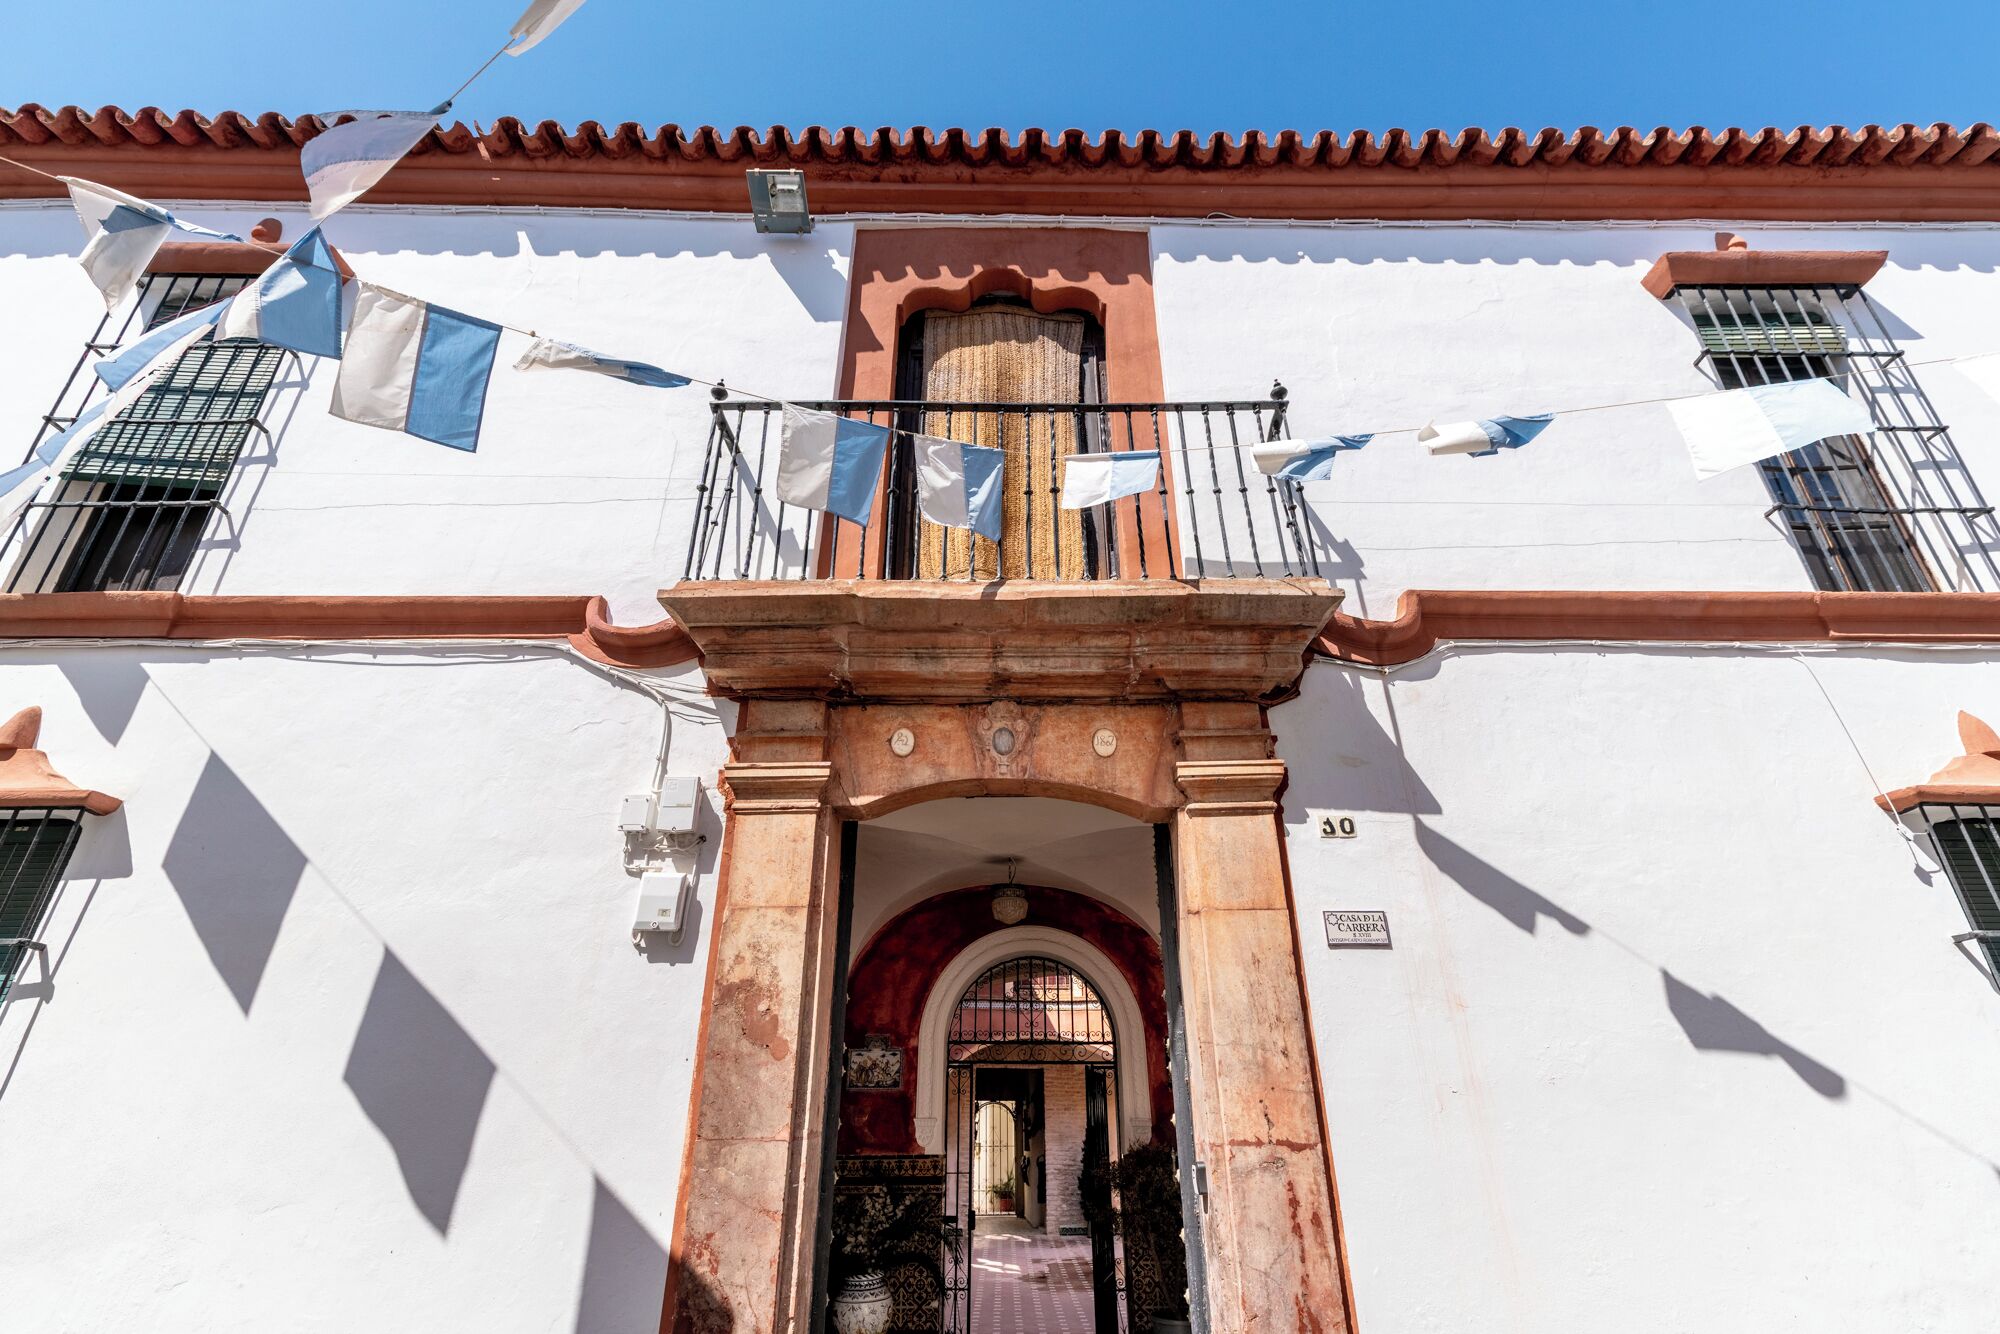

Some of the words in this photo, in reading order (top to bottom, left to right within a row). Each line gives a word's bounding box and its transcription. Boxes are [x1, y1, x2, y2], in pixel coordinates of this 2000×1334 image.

[1339, 914, 1362, 922] CASA
[1372, 914, 1383, 922] LA
[1338, 923, 1386, 932] CARRERA
